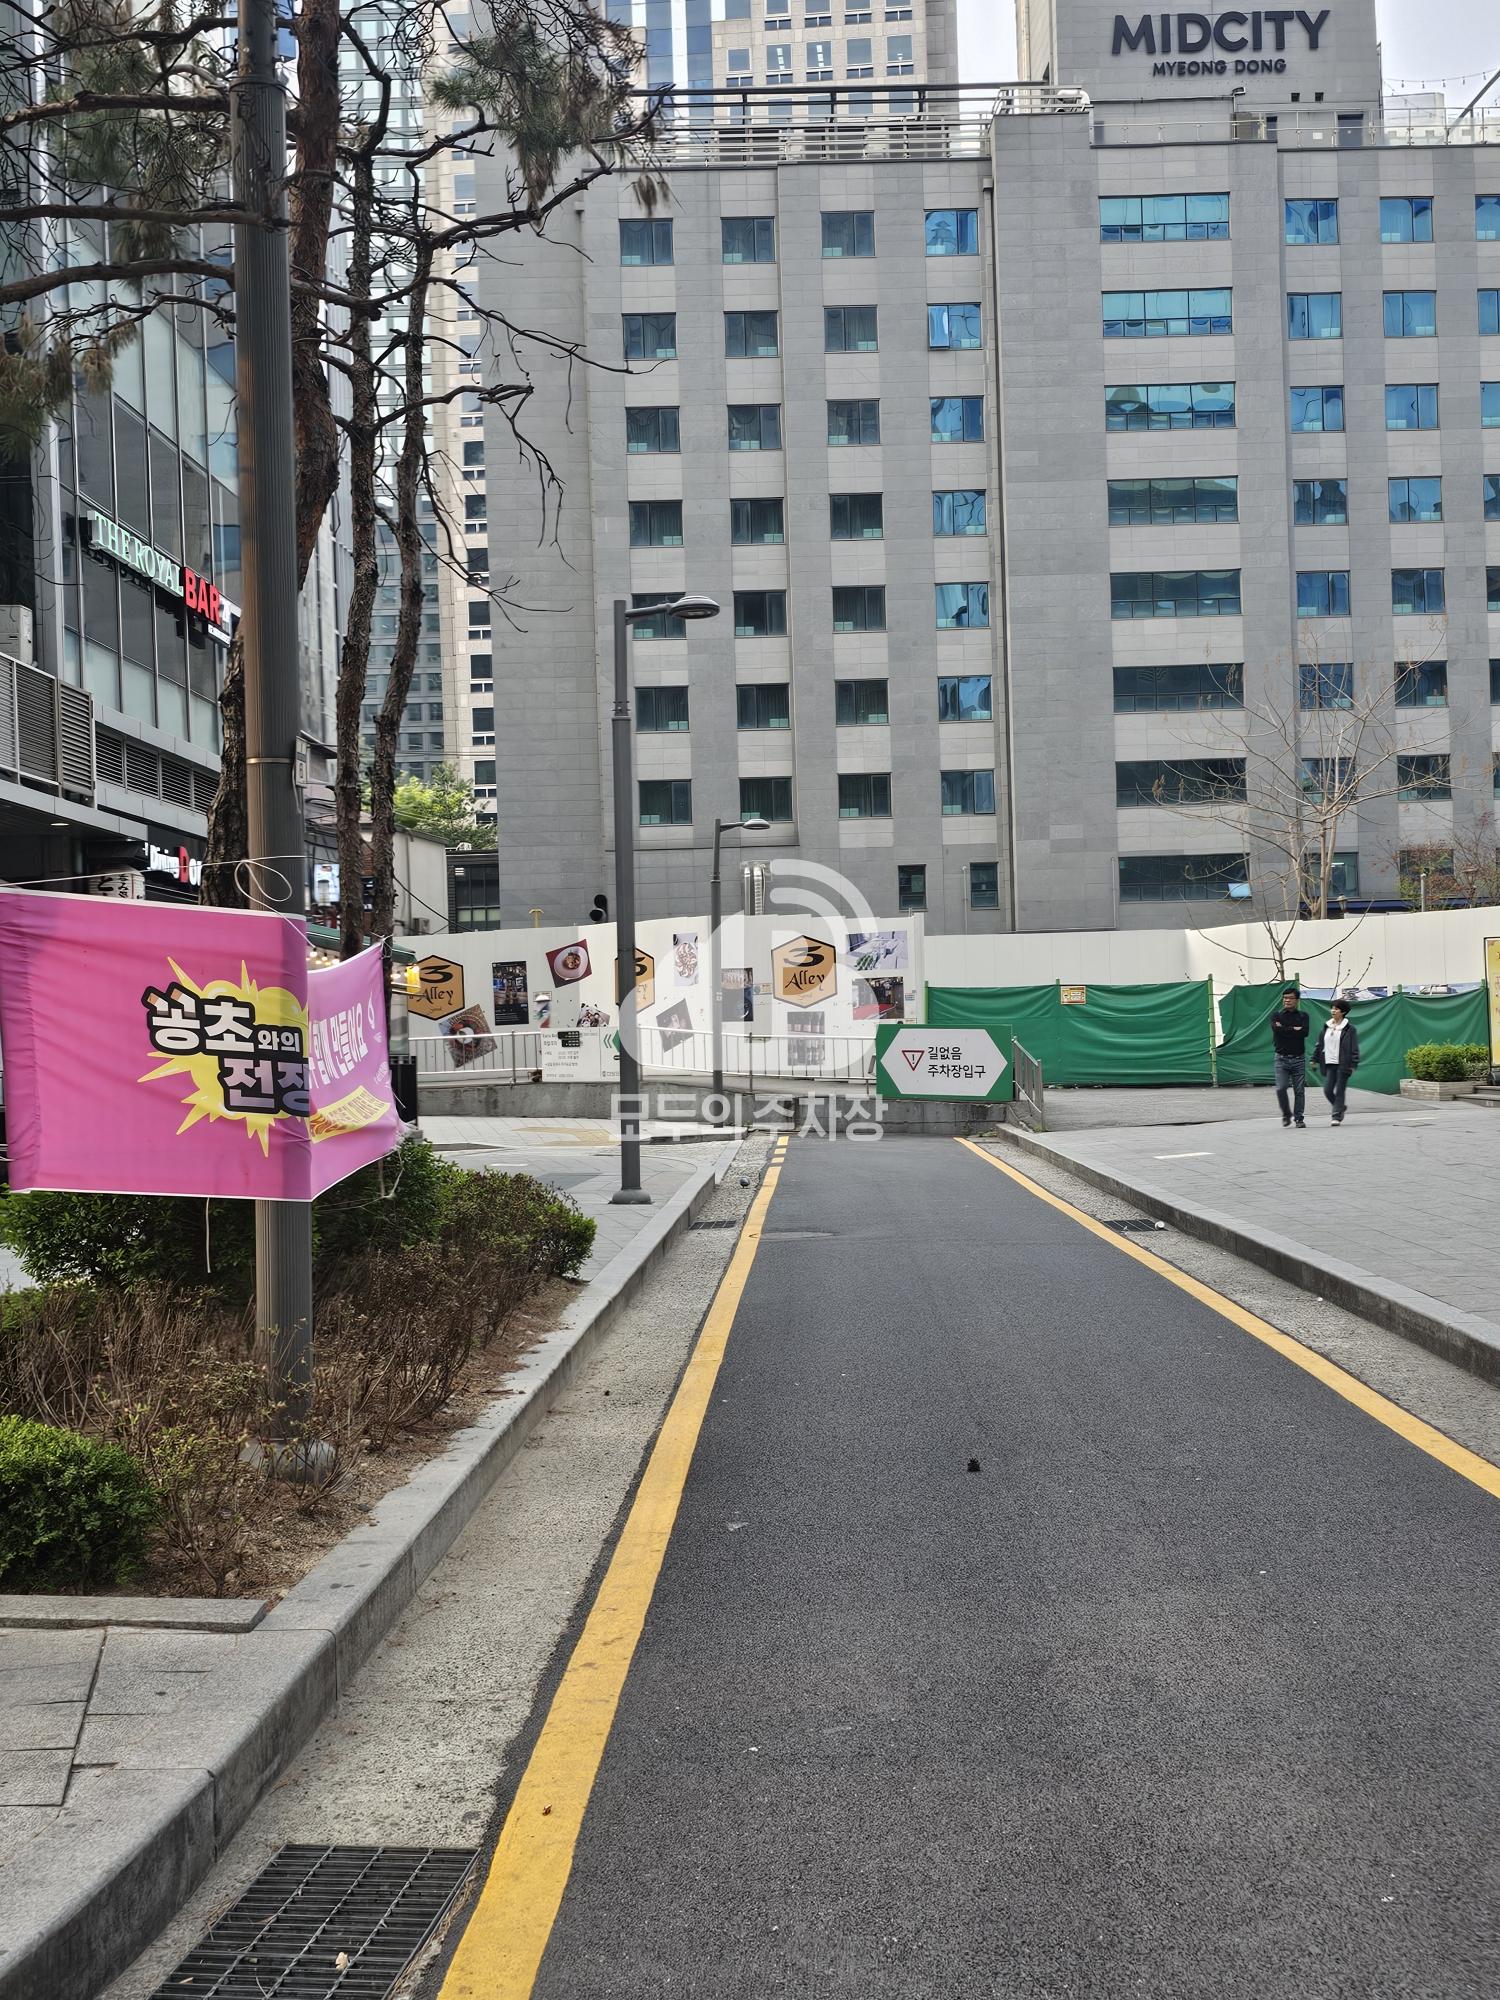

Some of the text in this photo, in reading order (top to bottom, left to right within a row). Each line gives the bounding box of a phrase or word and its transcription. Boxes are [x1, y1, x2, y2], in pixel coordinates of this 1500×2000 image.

[1112, 10, 1330, 55] MIDCITY
[1152, 58, 1287, 76] MYEONG DONG
[184, 567, 221, 625] BAR
[784, 970, 825, 991] Alley
[416, 986, 454, 1006] Alley
[927, 1046, 963, 1061] 길없음
[927, 1064, 987, 1079] 주차장입구
